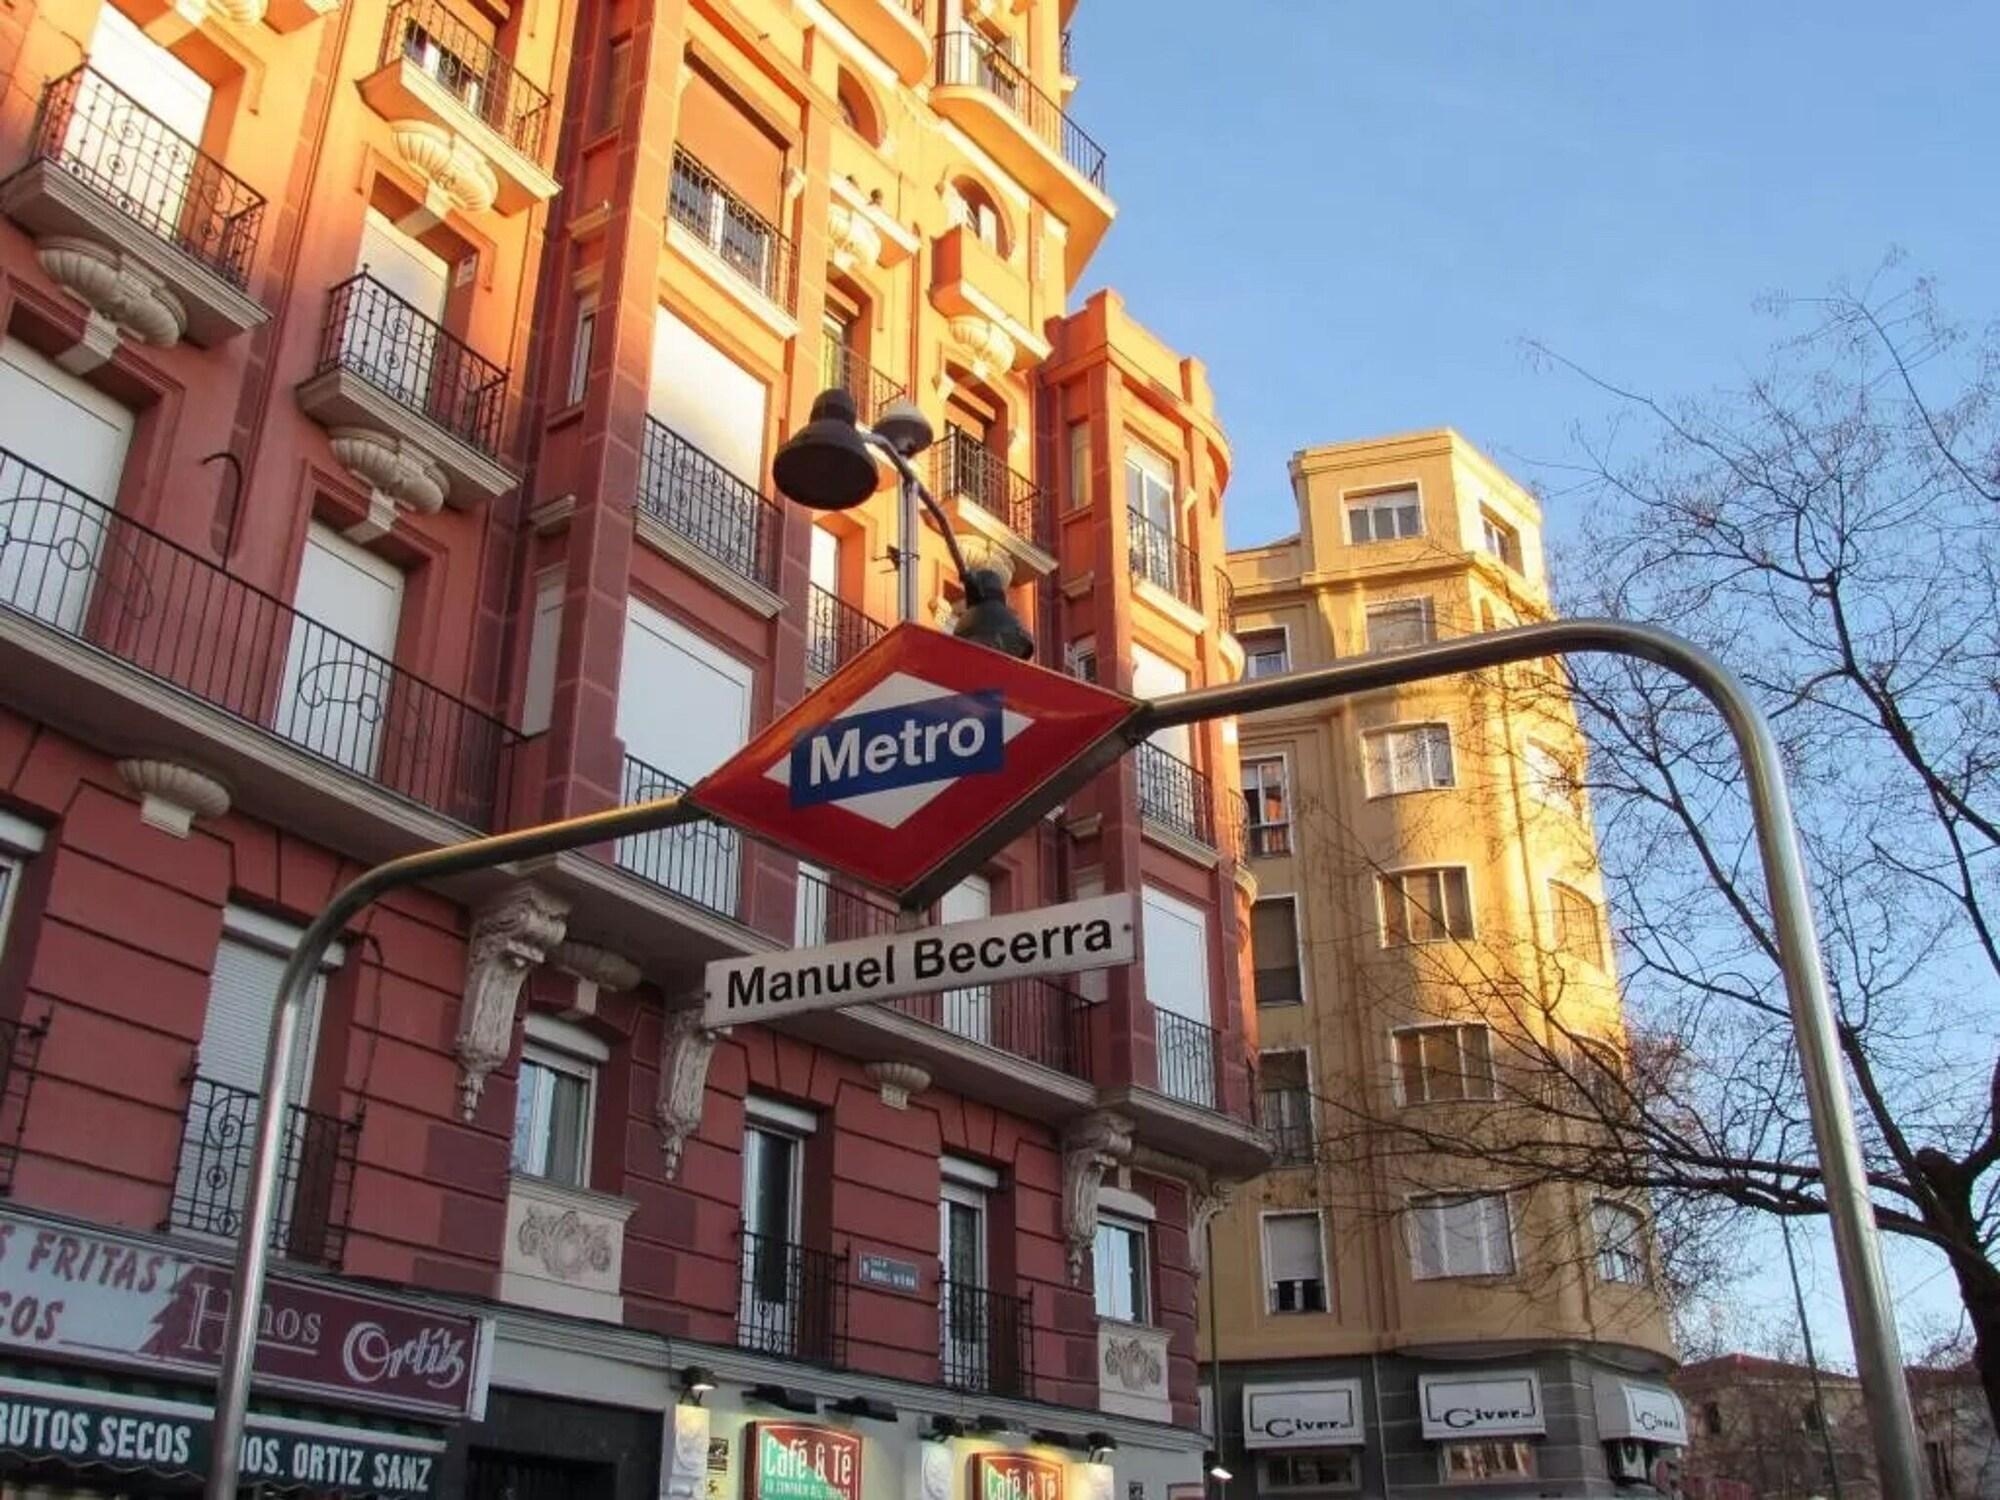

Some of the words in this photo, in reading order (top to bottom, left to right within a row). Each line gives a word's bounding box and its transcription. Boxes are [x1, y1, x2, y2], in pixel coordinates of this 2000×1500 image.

[809, 717, 985, 788] Metro
[727, 945, 895, 1008] Manuel
[914, 918, 1112, 980] Becerra
[28, 1230, 165, 1293] FRITAS
[98, 1416, 192, 1464] SECOS
[292, 1442, 365, 1485] ORTIZ
[372, 1453, 432, 1492] SANZ
[766, 1435, 808, 1479] Café
[815, 1442, 827, 1483] &
[832, 1445, 852, 1485] Té
